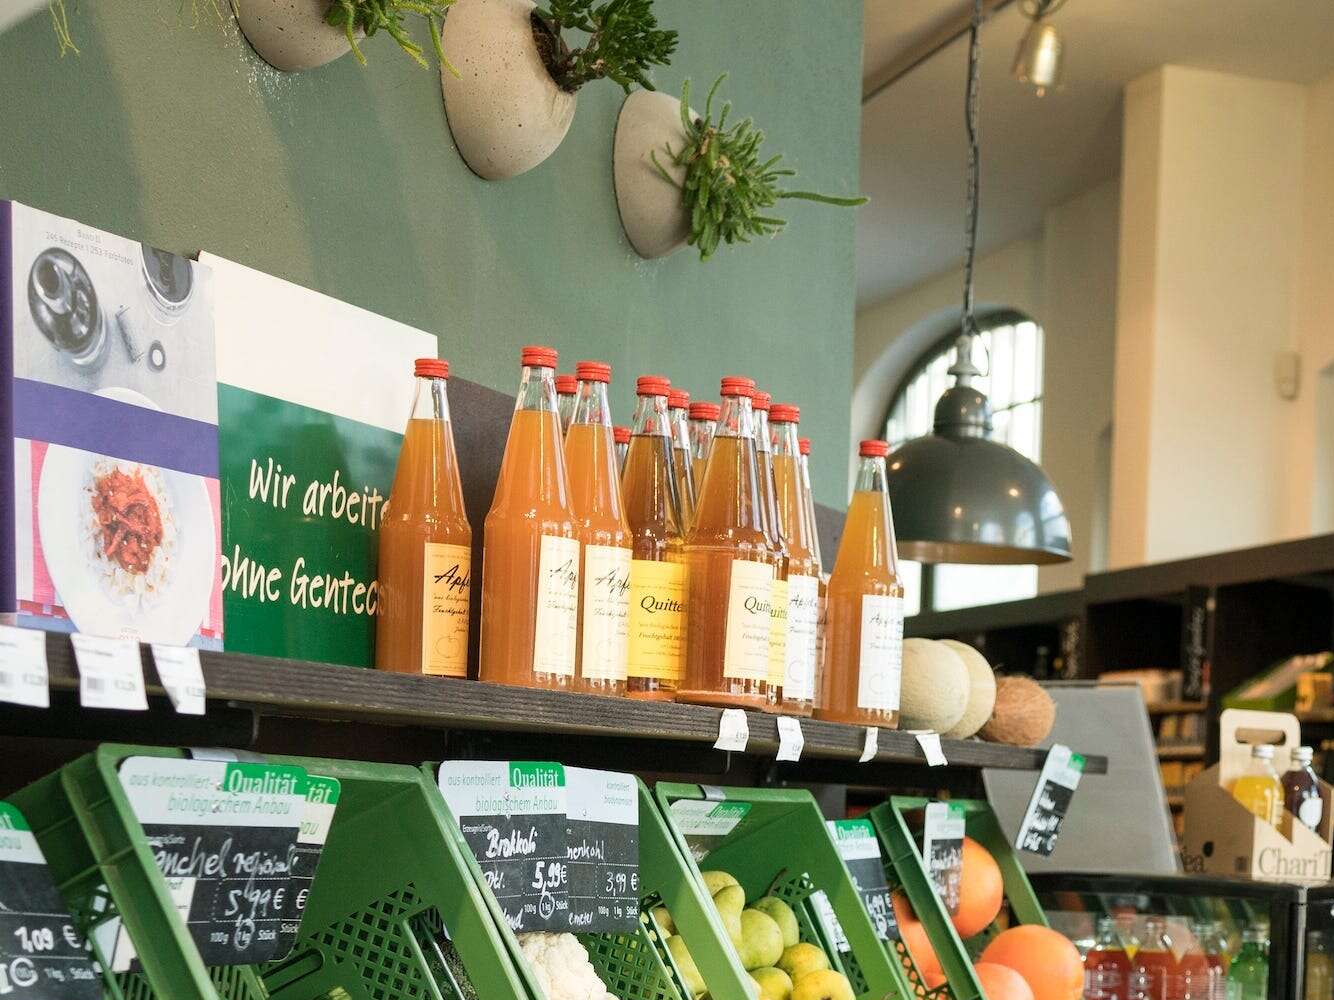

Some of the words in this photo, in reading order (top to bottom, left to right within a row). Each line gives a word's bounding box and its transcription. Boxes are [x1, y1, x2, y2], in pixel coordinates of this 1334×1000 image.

[249, 457, 296, 509] Wir
[302, 470, 391, 530] arbeite
[290, 557, 379, 616] Gentec
[228, 769, 298, 797] Qualität
[513, 767, 559, 789] Qualität
[155, 837, 232, 877] enchel
